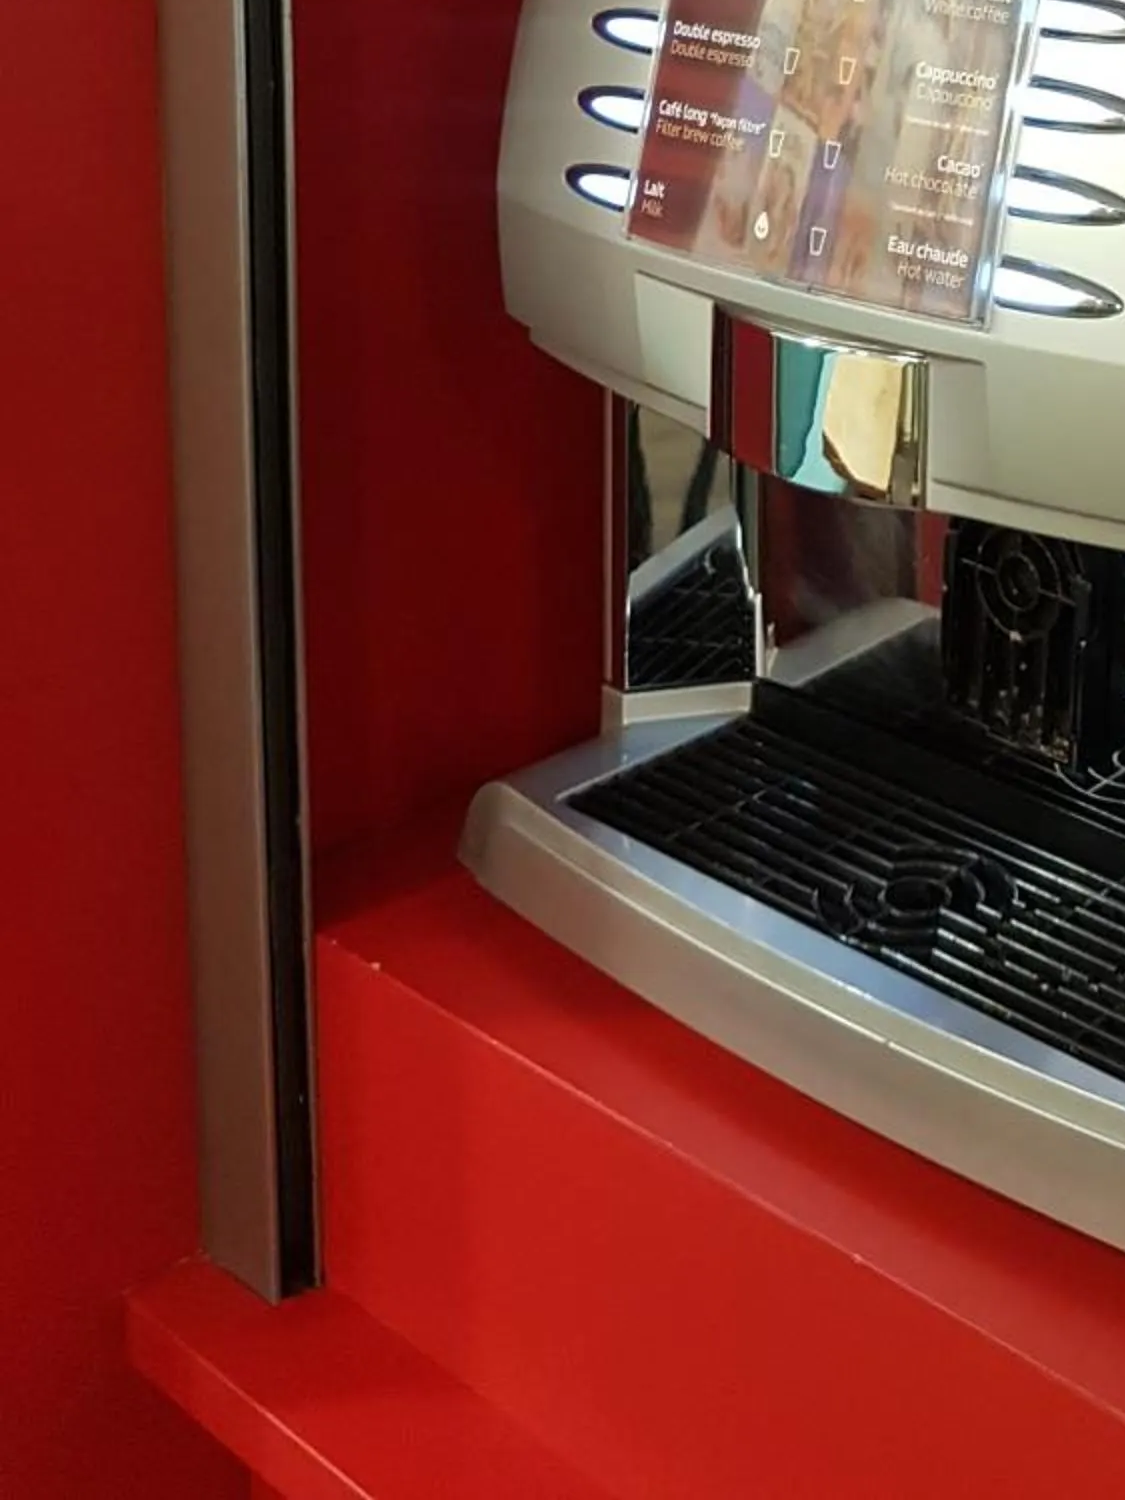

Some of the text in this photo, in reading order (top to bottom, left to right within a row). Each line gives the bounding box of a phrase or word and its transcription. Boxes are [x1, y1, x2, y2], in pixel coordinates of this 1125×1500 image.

[674, 20, 761, 49] Double espresso
[670, 39, 753, 68] Double espresso
[916, 61, 996, 90] Cappuccino
[659, 100, 682, 118] Café
[656, 118, 744, 150] Filter brew coffee
[937, 156, 980, 178] Cacao
[644, 179, 665, 198] Lait
[884, 167, 978, 199] Hot chocolate
[641, 199, 663, 217] Milk
[887, 235, 968, 268] Eau chaude
[896, 261, 966, 290] Hot water
